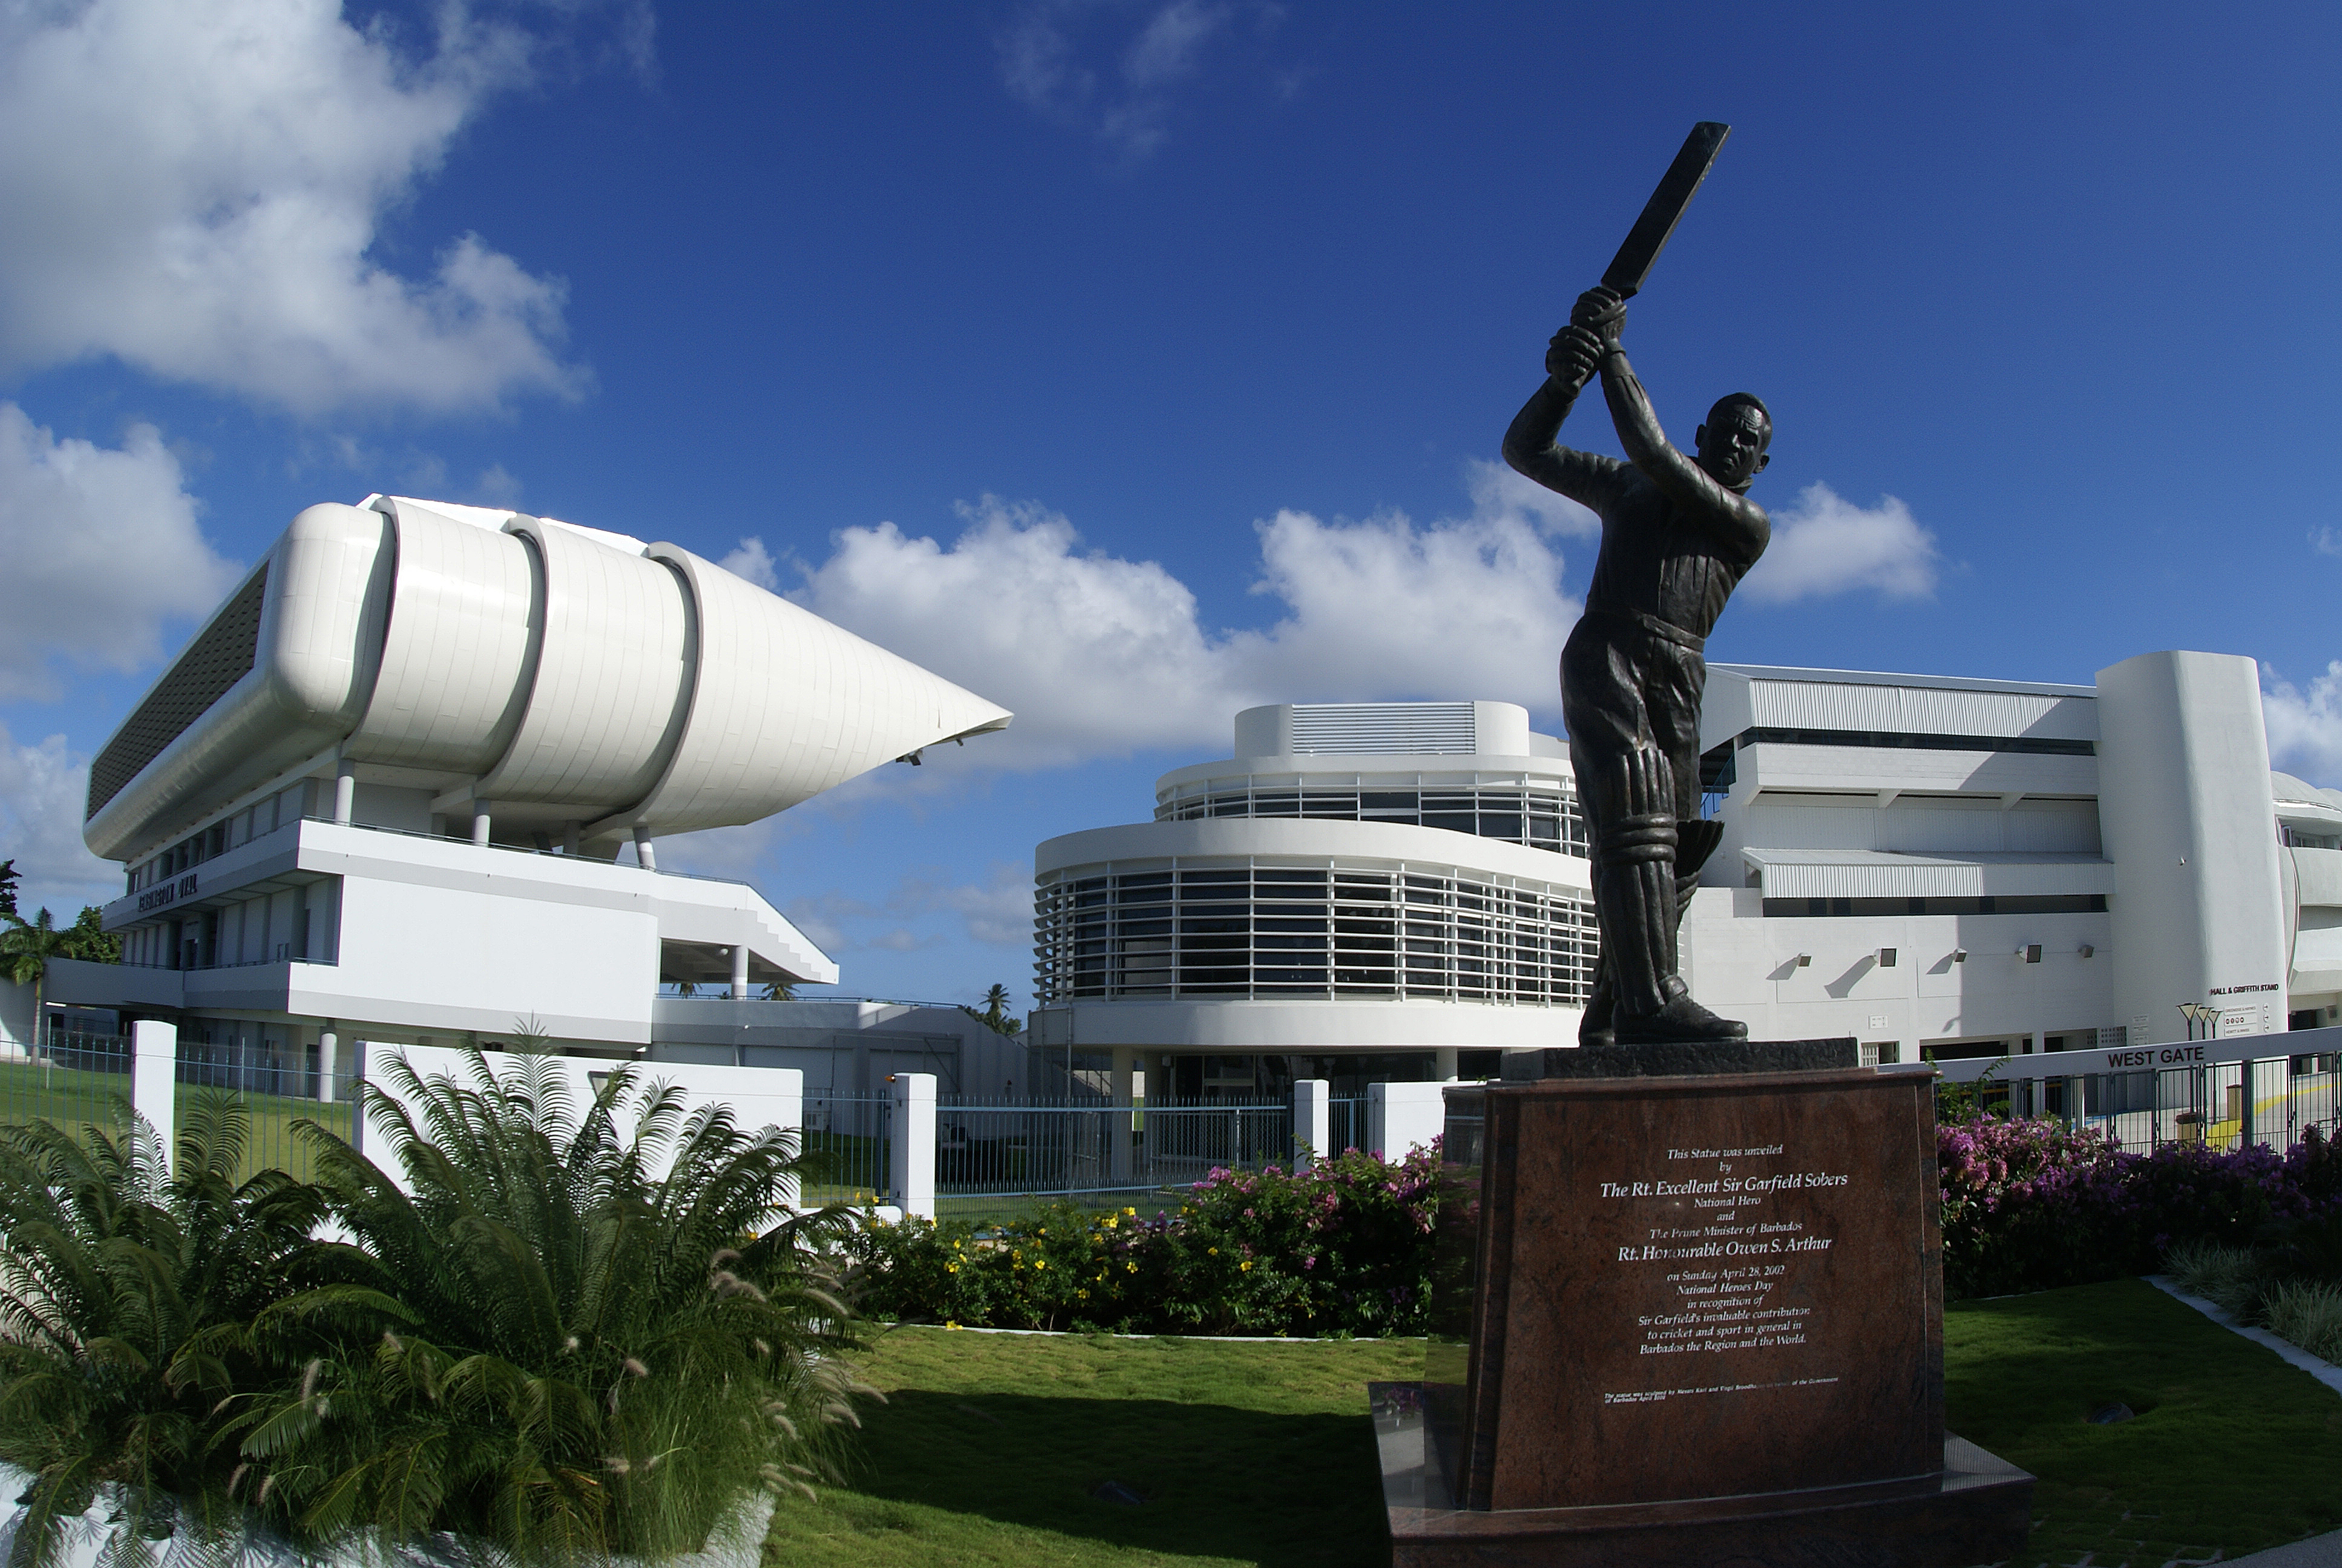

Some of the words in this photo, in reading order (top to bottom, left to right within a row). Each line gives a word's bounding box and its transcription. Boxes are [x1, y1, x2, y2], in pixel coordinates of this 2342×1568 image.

[2234, 985, 2259, 993] GRIFFITH
[2108, 1051, 2155, 1068] WEST
[2160, 1046, 2204, 1063] GATE
[1667, 1149, 1688, 1160] This
[1691, 1148, 1720, 1159] Statue
[1723, 1148, 1742, 1157] was
[1744, 1144, 1783, 1156] unveiled
[1719, 1161, 1732, 1174] by
[1601, 1182, 1629, 1198] The
[1632, 1181, 1653, 1196] Rt.
[1656, 1179, 1719, 1195] Excellent
[1722, 1177, 1742, 1192] Sir
[1744, 1173, 1802, 1195] Garfield
[1805, 1172, 1848, 1187] Sobers
[1694, 1196, 1735, 1208] National
[1737, 1195, 1761, 1206] Hero
[1716, 1210, 1735, 1221] and
[1650, 1228, 1668, 1239] The
[1671, 1227, 1701, 1238] Prime
[1703, 1225, 1744, 1237] Minister
[1746, 1222, 1757, 1237] of
[1760, 1221, 1803, 1233] Barbados
[1618, 1246, 1639, 1261] Rt.
[1642, 1242, 1724, 1261] Honourable
[1726, 1241, 1768, 1256] Owen
[1771, 1238, 1782, 1253] S.
[1785, 1236, 1832, 1252] Arthur
[1667, 1273, 1679, 1282] on
[1682, 1269, 1717, 1282] Sunday
[1720, 1267, 1746, 1281] April
[1748, 1266, 1761, 1277] 28,
[1763, 1264, 1785, 1276] 2002
[1676, 1283, 1717, 1296] National
[1720, 1282, 1752, 1293] Heroes
[1754, 1281, 1774, 1292] Day
[1687, 1299, 1697, 1309] in
[1699, 1296, 1751, 1310] recognition
[1753, 1294, 1765, 1307] of
[1638, 1315, 1652, 1326] Sir
[1654, 1313, 1701, 1327] Garfield's
[1703, 1310, 1751, 1322] invaluable
[1753, 1307, 1811, 1319] contribution
[1647, 1330, 1658, 1340] to
[1659, 1327, 1693, 1339] cricket
[1696, 1326, 1714, 1337] and
[1716, 1325, 1742, 1338] sport
[1744, 1323, 1754, 1333] in
[1756, 1320, 1790, 1336] general
[1793, 1319, 1802, 1330] in
[1640, 1342, 1685, 1355] Barbados
[1687, 1340, 1702, 1351] the
[1704, 1339, 1737, 1353] Region
[1739, 1337, 1757, 1348] and
[1759, 1336, 1774, 1347] the
[1777, 1333, 1806, 1345] World.
